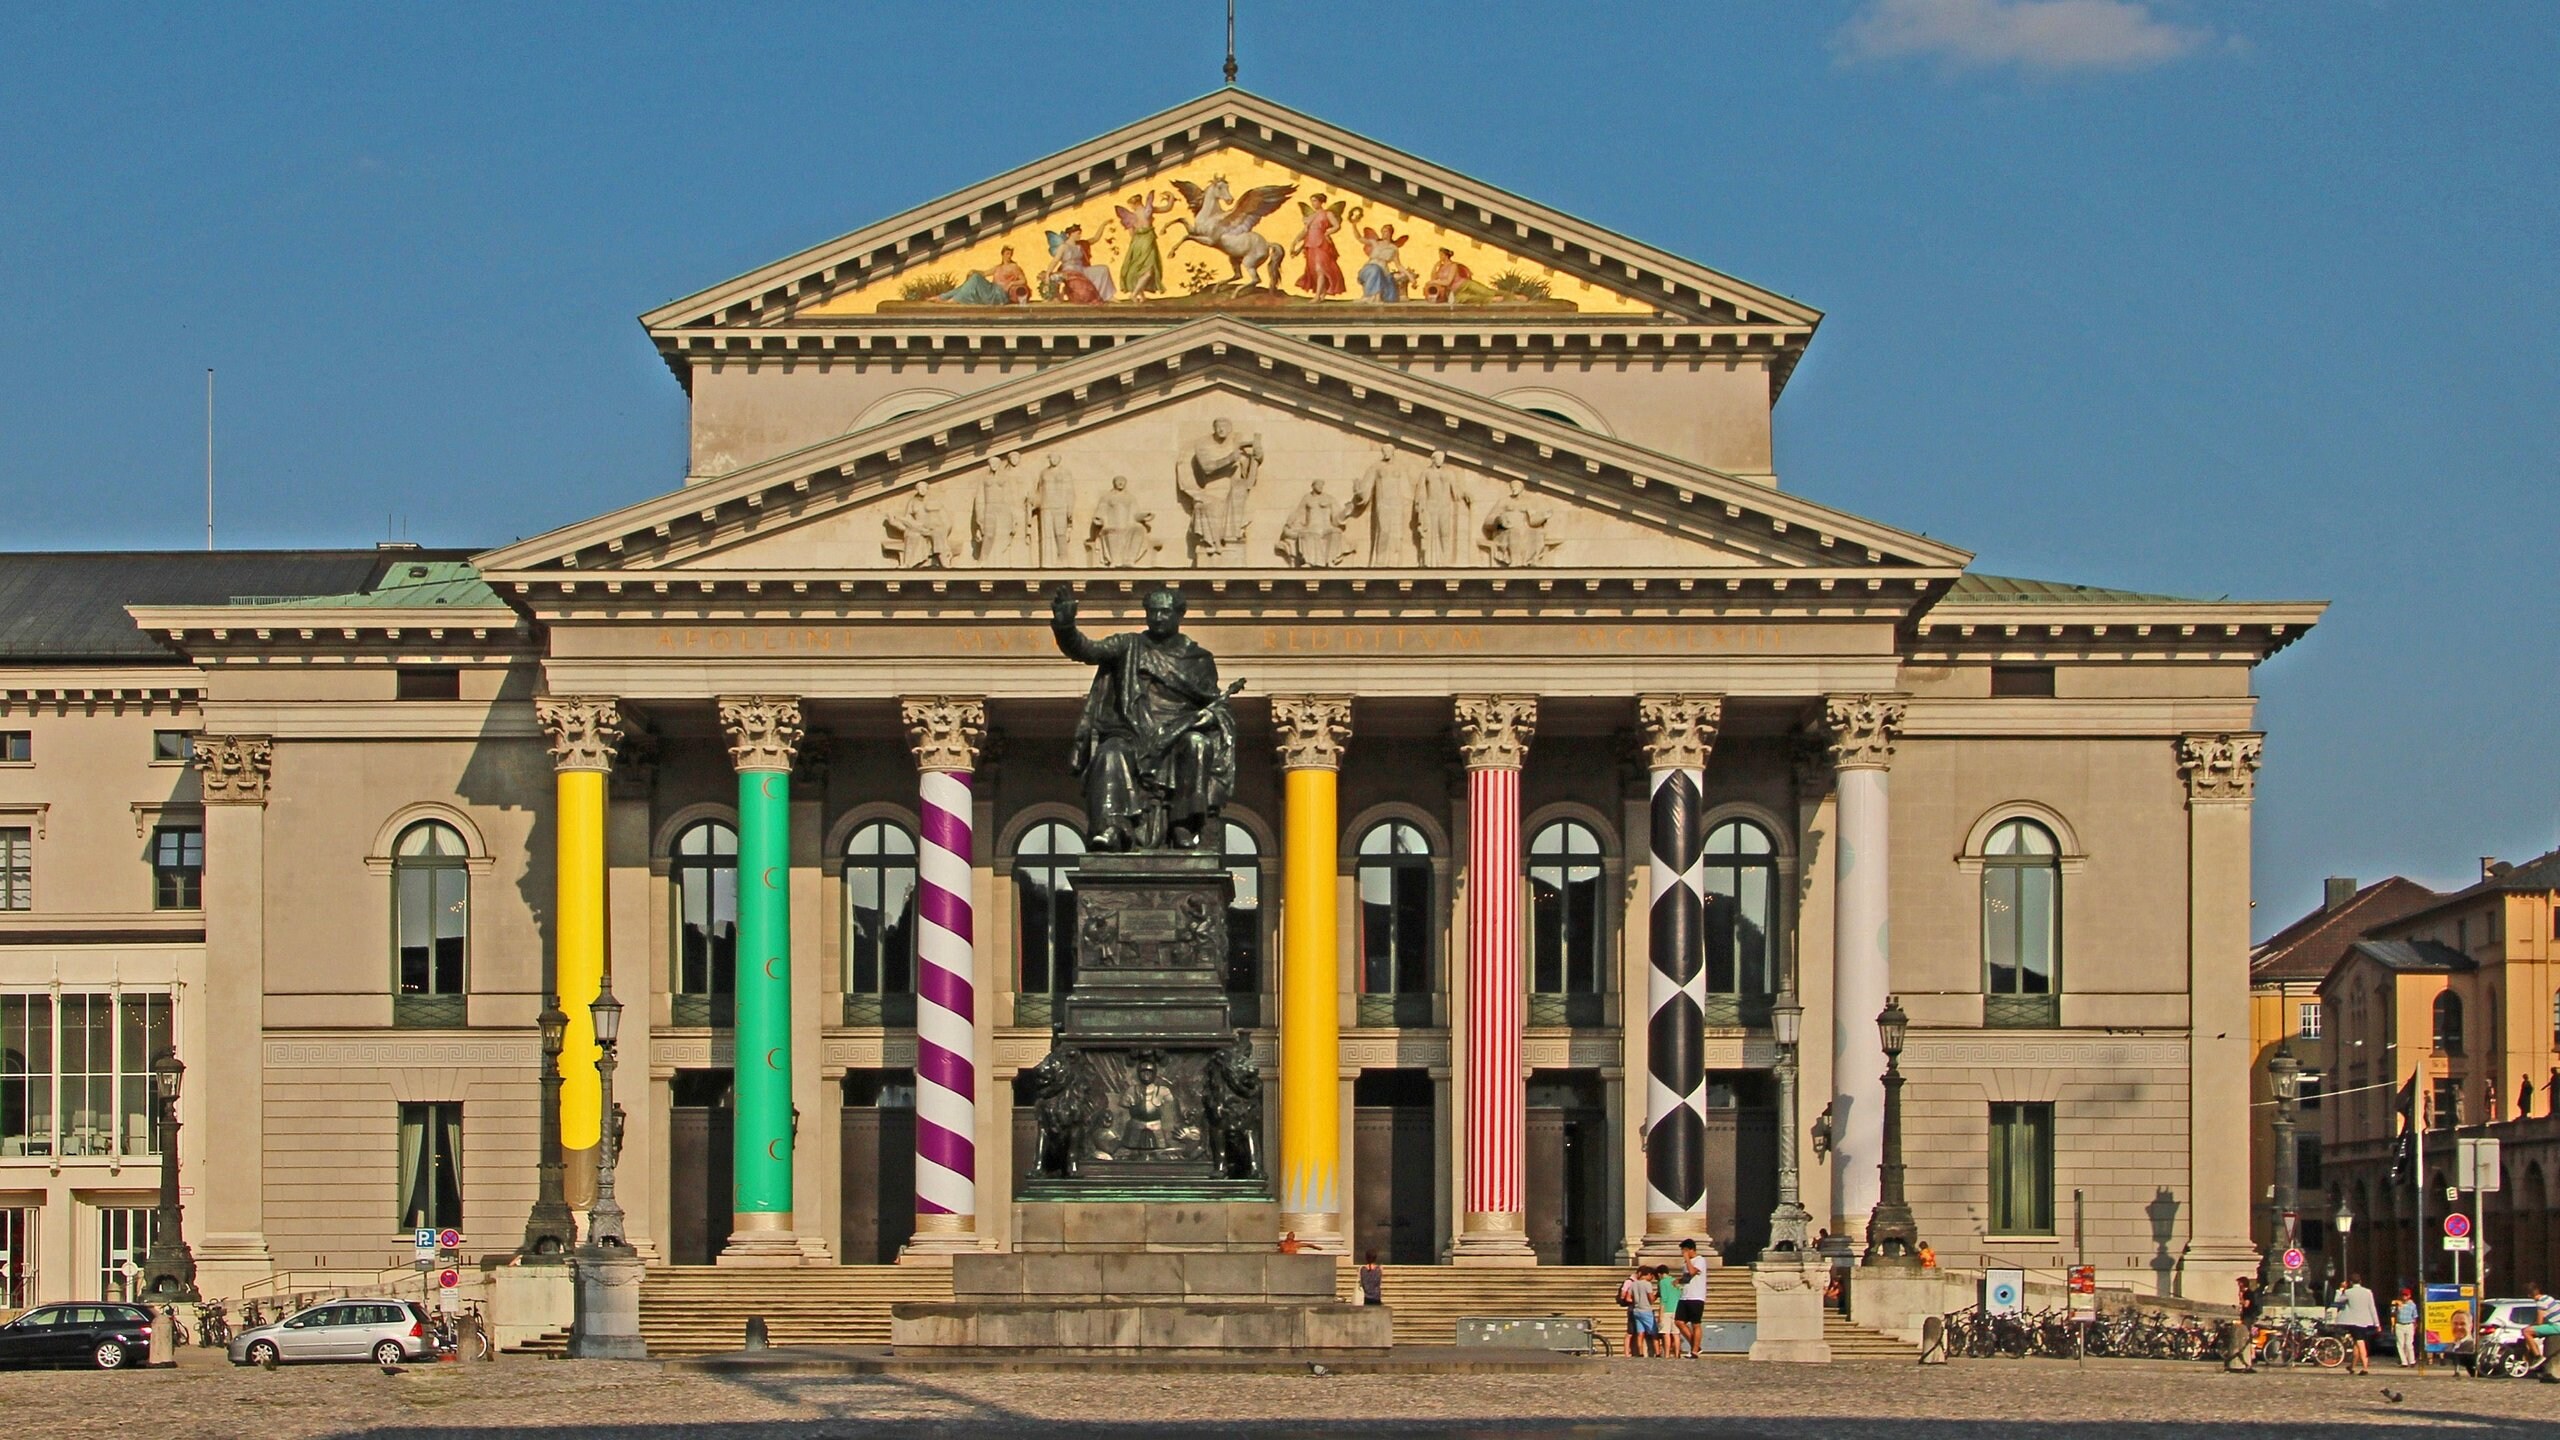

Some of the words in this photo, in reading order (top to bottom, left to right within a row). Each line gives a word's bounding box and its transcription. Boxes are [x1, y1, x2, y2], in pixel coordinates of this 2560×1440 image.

[656, 629, 852, 650] APOLLINI
[1263, 628, 1483, 649] REDDITVM
[1575, 627, 1781, 649] MCMLXIII
[418, 1231, 430, 1246] P
